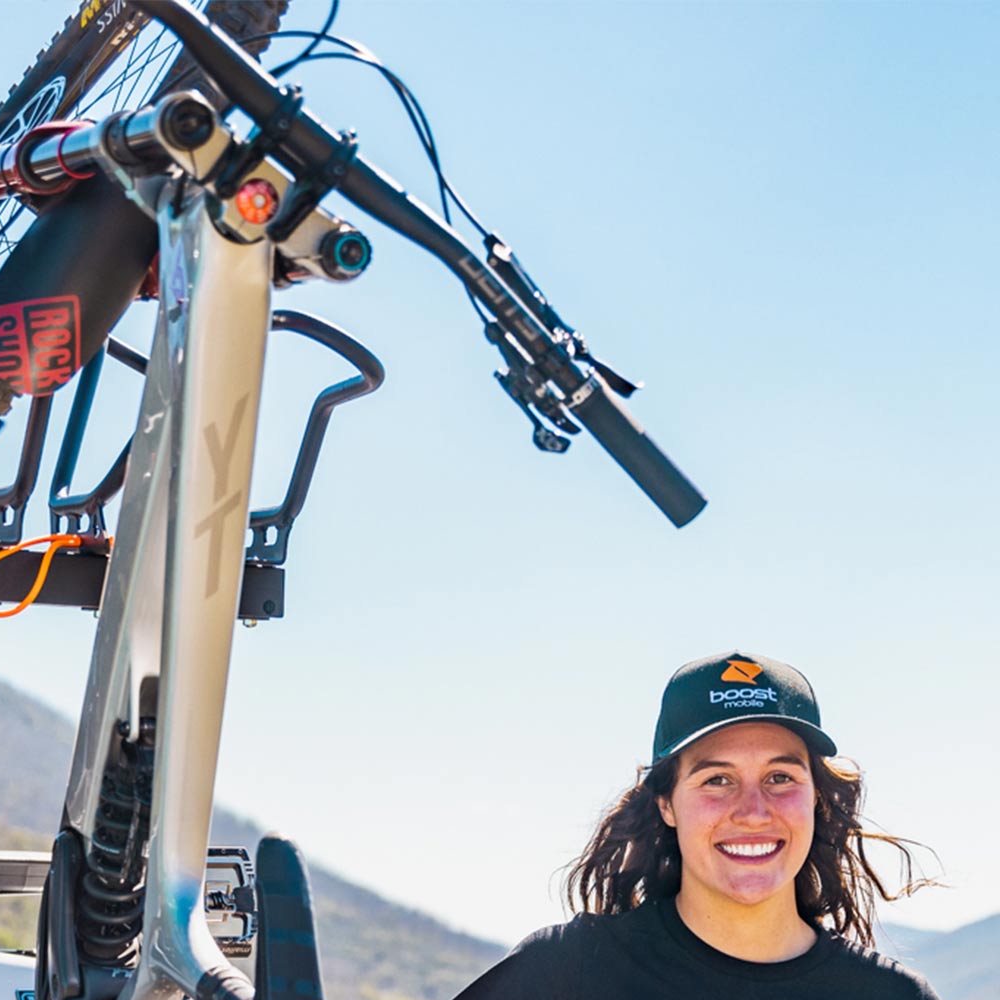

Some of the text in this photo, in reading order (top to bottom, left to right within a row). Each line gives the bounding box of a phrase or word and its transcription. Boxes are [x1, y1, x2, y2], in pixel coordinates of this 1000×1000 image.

[28, 306, 73, 389] ROCK
[193, 391, 250, 600] YT
[709, 687, 778, 703] boost
